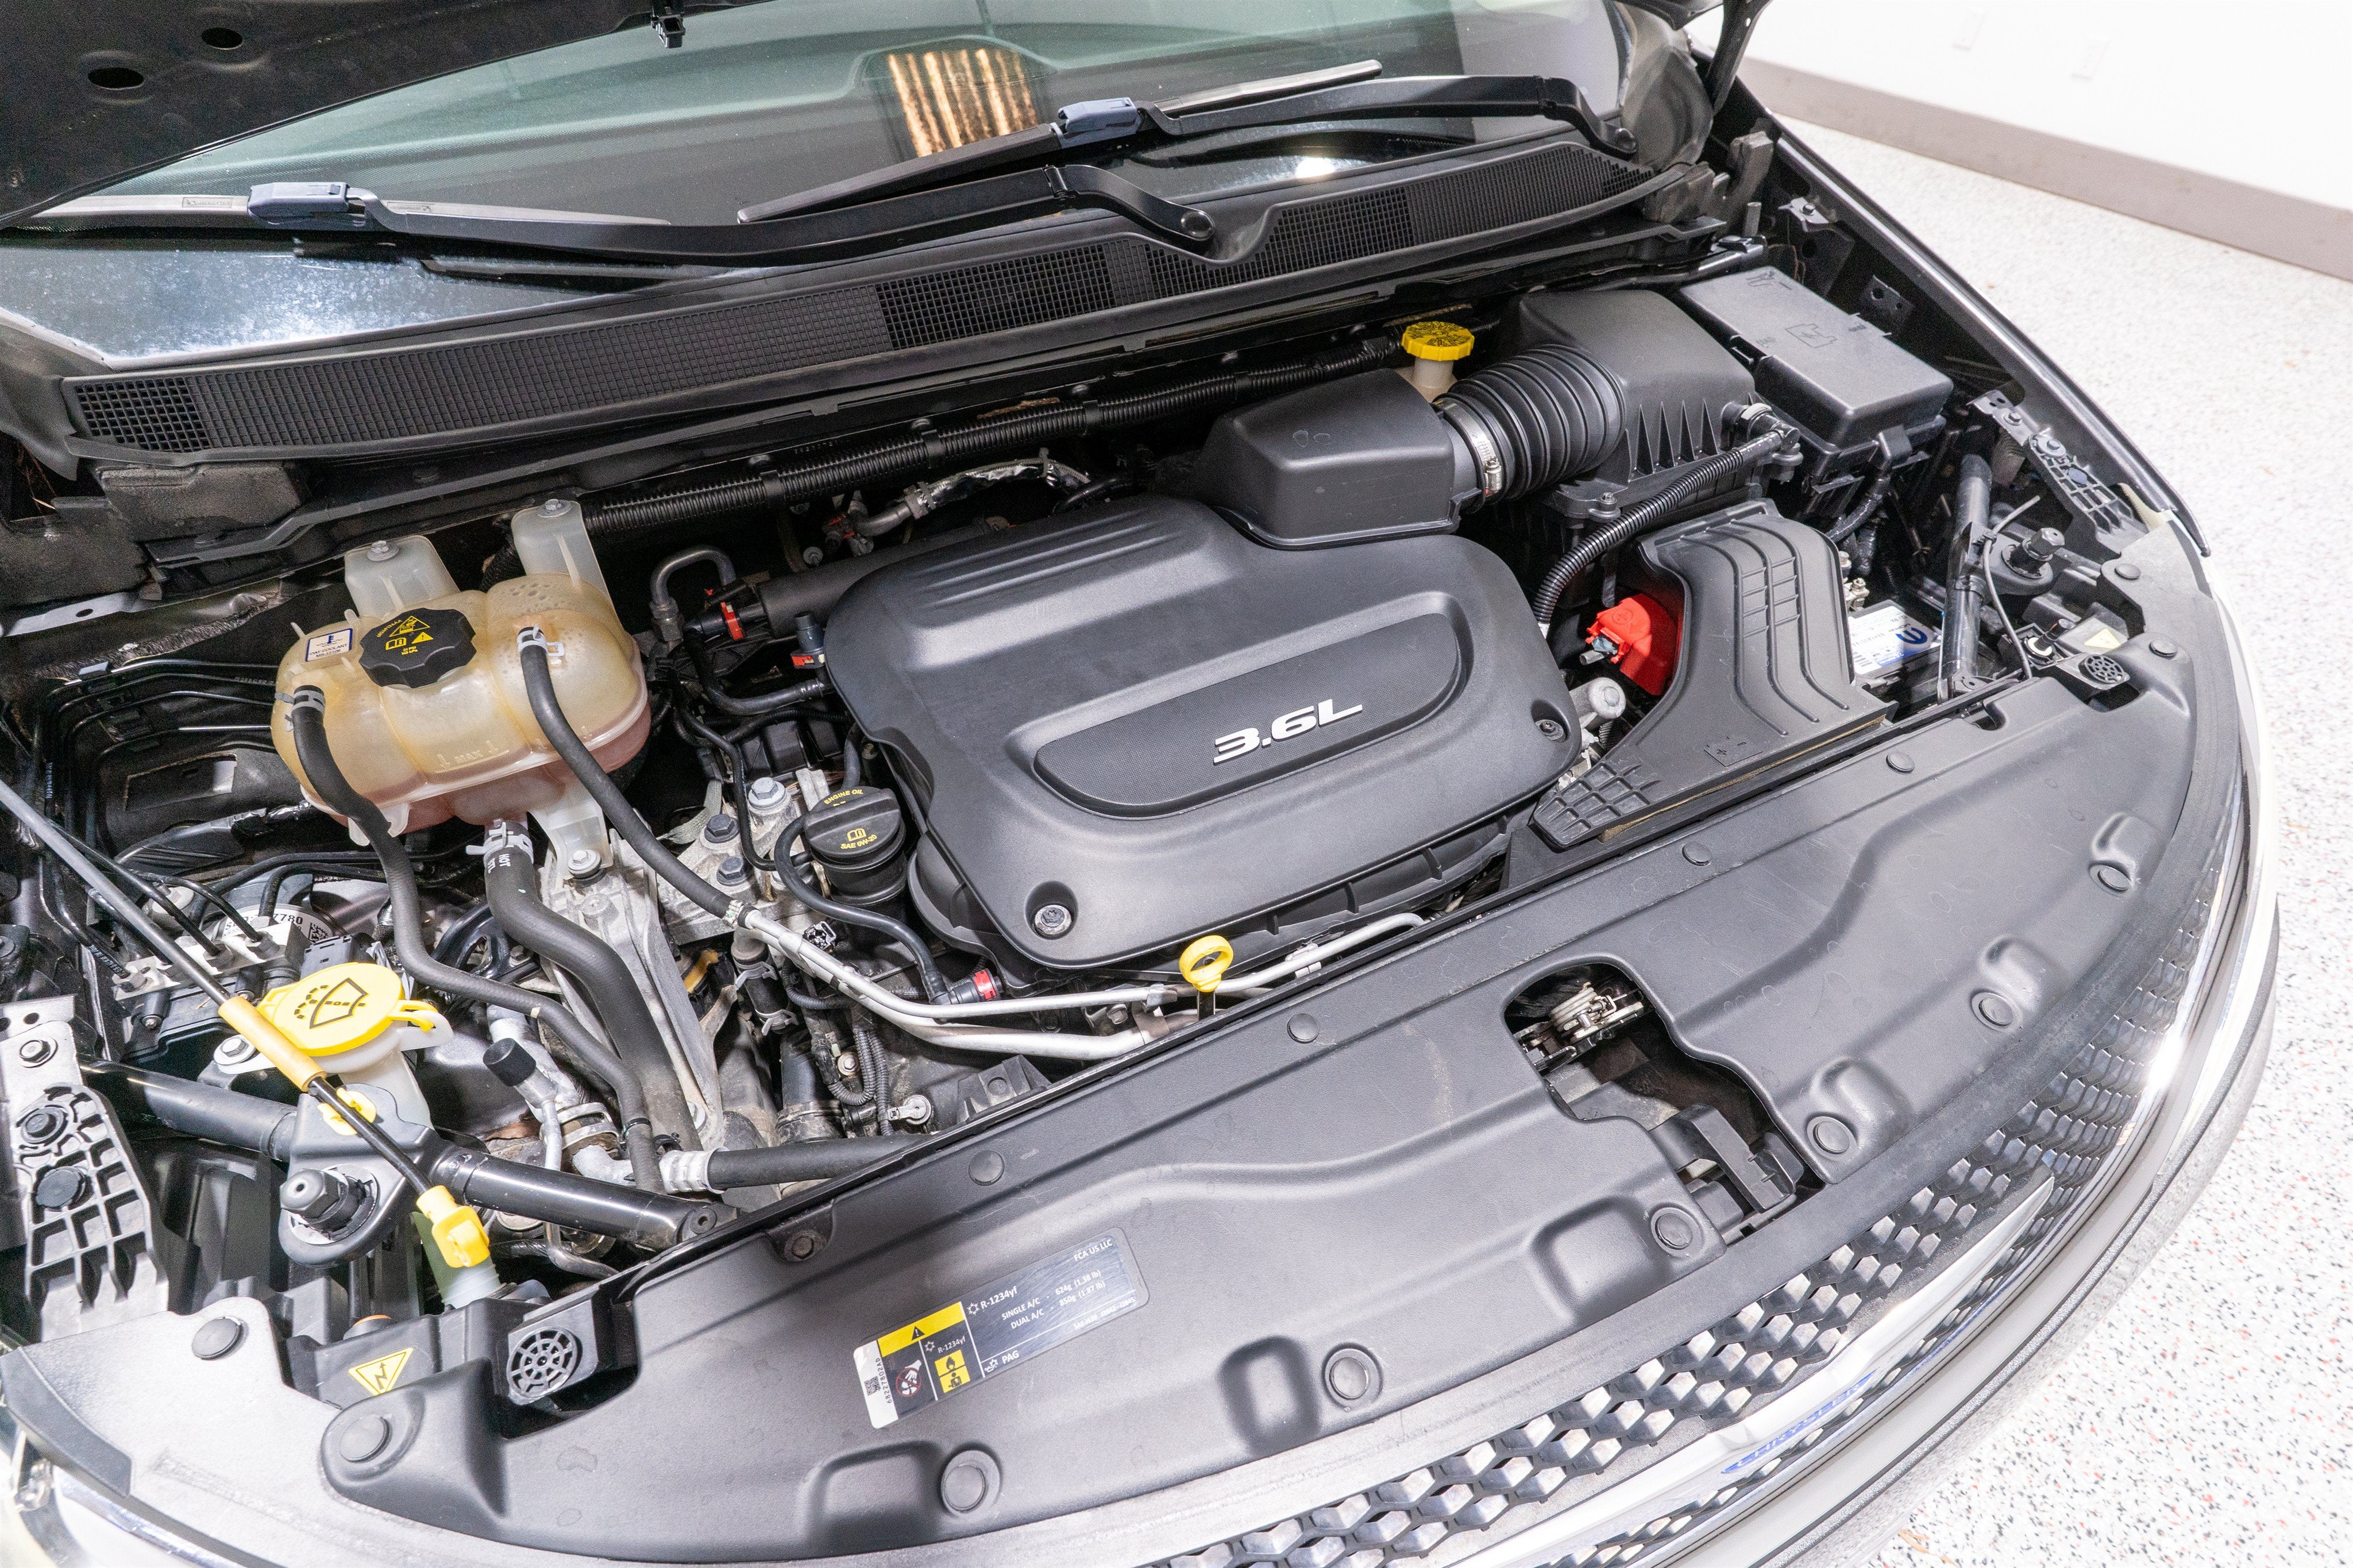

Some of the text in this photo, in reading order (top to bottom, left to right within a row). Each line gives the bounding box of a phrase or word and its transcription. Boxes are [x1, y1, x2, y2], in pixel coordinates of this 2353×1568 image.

[1213, 698, 1363, 765] 3.6L
[454, 750, 483, 763] MAX
[824, 790, 850, 805] ENGINE
[857, 834, 877, 847] 0W-20
[499, 853, 511, 867] HOT
[1074, 1239, 1113, 1261] FCA US LLC
[980, 1286, 1017, 1309] R-1234yf
[1001, 1304, 1027, 1320] SINGLE
[1027, 1297, 1040, 1308] A/C
[1055, 1284, 1073, 1295] 624g
[1074, 1275, 1091, 1287] (1.38
[1091, 1269, 1101, 1279] lb)
[1010, 1316, 1031, 1329] DUAL
[1031, 1308, 1044, 1320] A/C
[1059, 1295, 1077, 1306] 850g
[1078, 1285, 1095, 1299] (1.87
[1095, 1280, 1106, 1289] lb)
[938, 1335, 966, 1354] R-1234yf
[1002, 1350, 1020, 1364] PAG
[875, 1358, 892, 1404] 68227802AD
[1737, 1385, 1861, 1467] CHRYSLER
